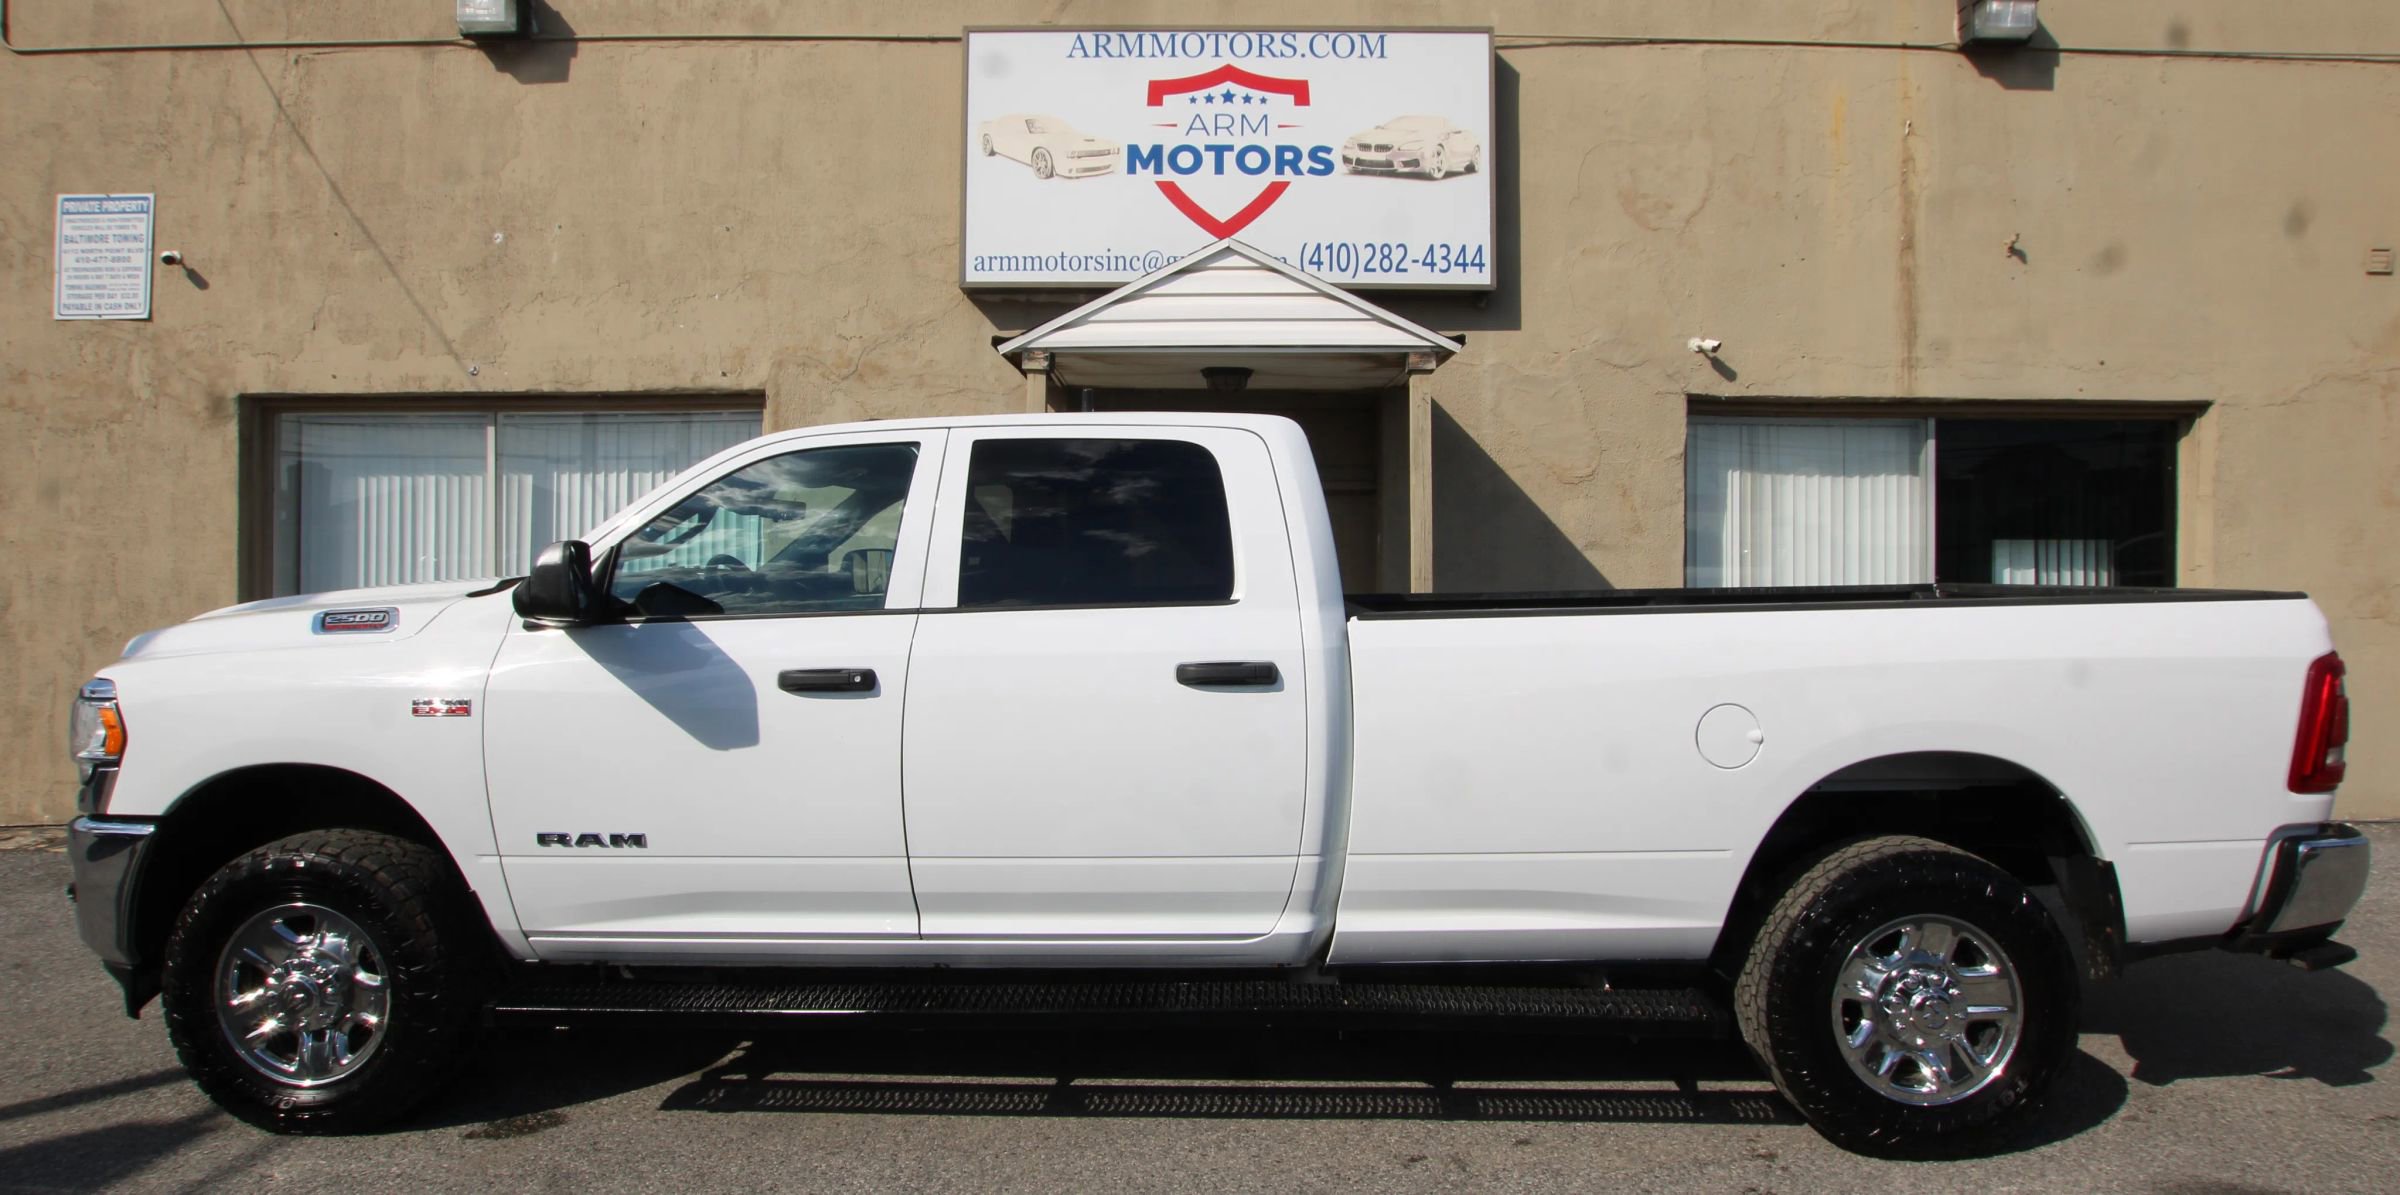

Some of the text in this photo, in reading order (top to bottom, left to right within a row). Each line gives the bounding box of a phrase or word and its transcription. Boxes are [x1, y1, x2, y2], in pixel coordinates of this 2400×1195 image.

[1066, 32, 1388, 60] ARMMOTORS.COM
[1185, 112, 1269, 137] ARM
[1126, 143, 1335, 177] MOTORS
[63, 200, 148, 213] PRIVATE PROPERTY
[63, 234, 145, 245] BALTIMORE TOWING
[1300, 242, 1486, 280] (410)282-4344
[63, 303, 93, 311] PAYABLE
[104, 303, 122, 311] CASH
[327, 611, 387, 624] 2500
[536, 832, 648, 848] RAM
